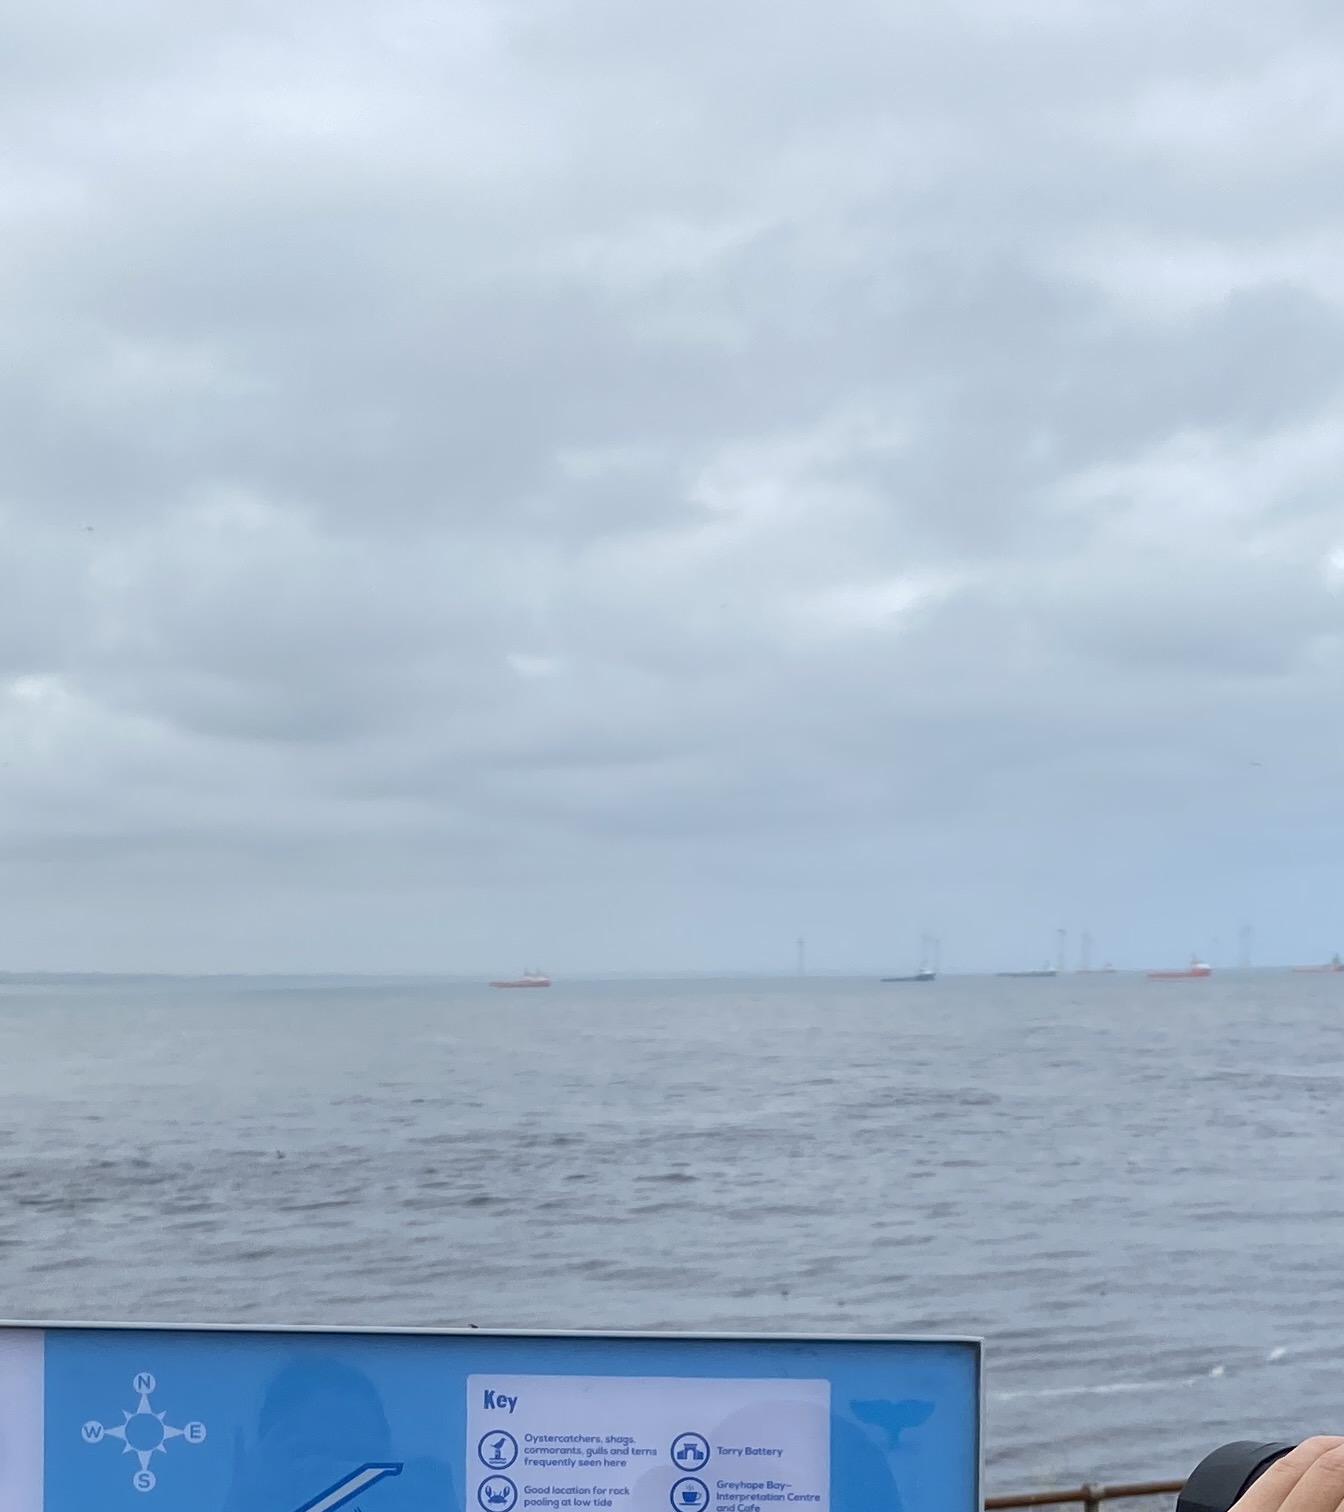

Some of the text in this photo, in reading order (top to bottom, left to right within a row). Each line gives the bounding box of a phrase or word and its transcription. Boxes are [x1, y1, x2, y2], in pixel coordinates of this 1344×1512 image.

[137, 1375, 152, 1390] N
[484, 1390, 518, 1413] Key
[84, 1425, 102, 1438] W
[190, 1425, 202, 1439] E
[586, 1446, 608, 1458] gulls
[609, 1446, 630, 1456] and
[631, 1447, 658, 1456] terns
[716, 1446, 784, 1458] Torry Battery
[524, 1457, 627, 1468] frequently seen here
[138, 1474, 151, 1488] S
[716, 1480, 765, 1492] Greyhope
[524, 1486, 630, 1496] Good location for rock
[524, 1498, 613, 1509] pooling at low tide
[716, 1492, 821, 1503] Interpretation Centre
[716, 1503, 761, 1512] and Cafe
